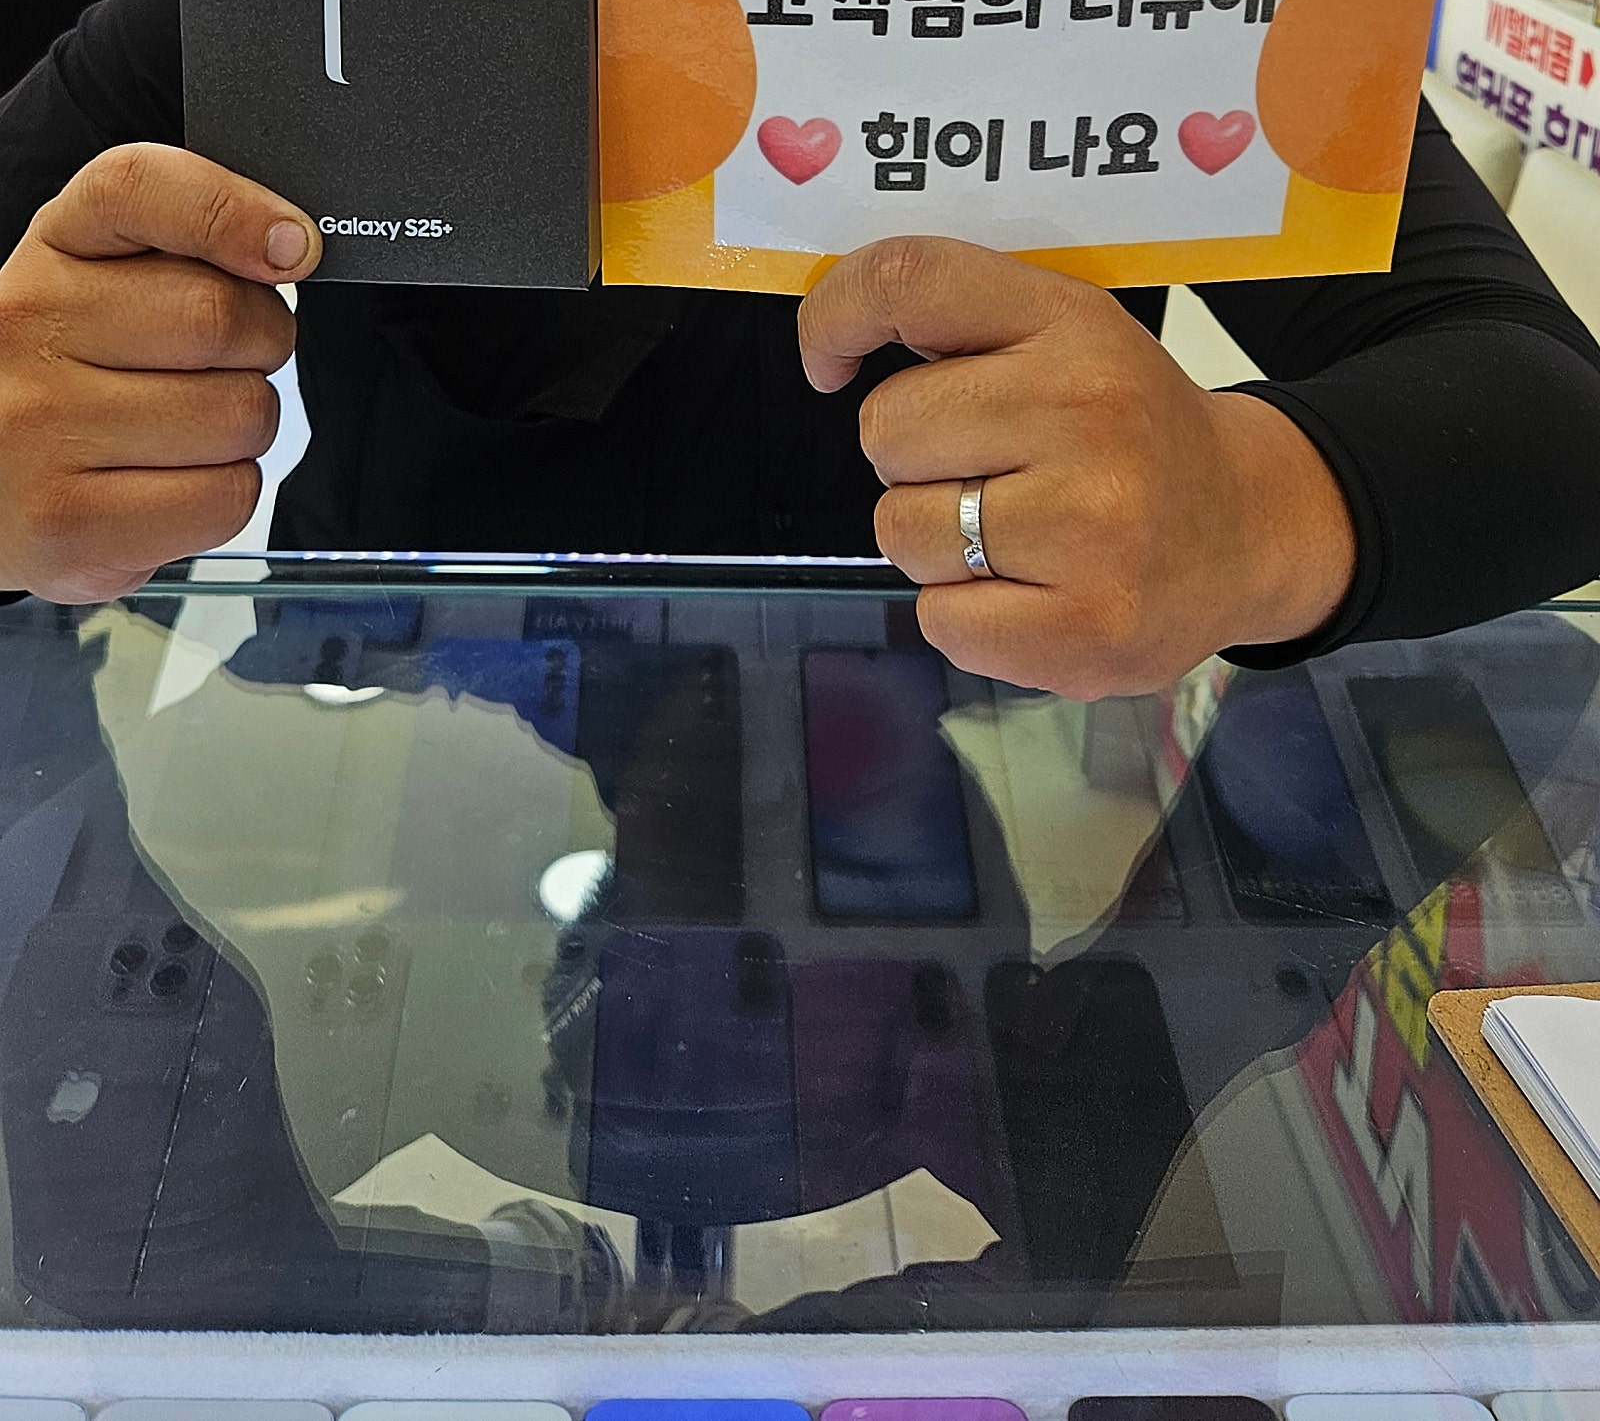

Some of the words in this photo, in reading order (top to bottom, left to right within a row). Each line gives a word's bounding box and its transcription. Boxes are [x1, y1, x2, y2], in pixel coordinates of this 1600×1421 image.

[861, 111, 1005, 191] 힘이
[1029, 112, 1160, 178] 나요
[318, 216, 402, 241] Galaxy
[404, 218, 454, 238] S25+
